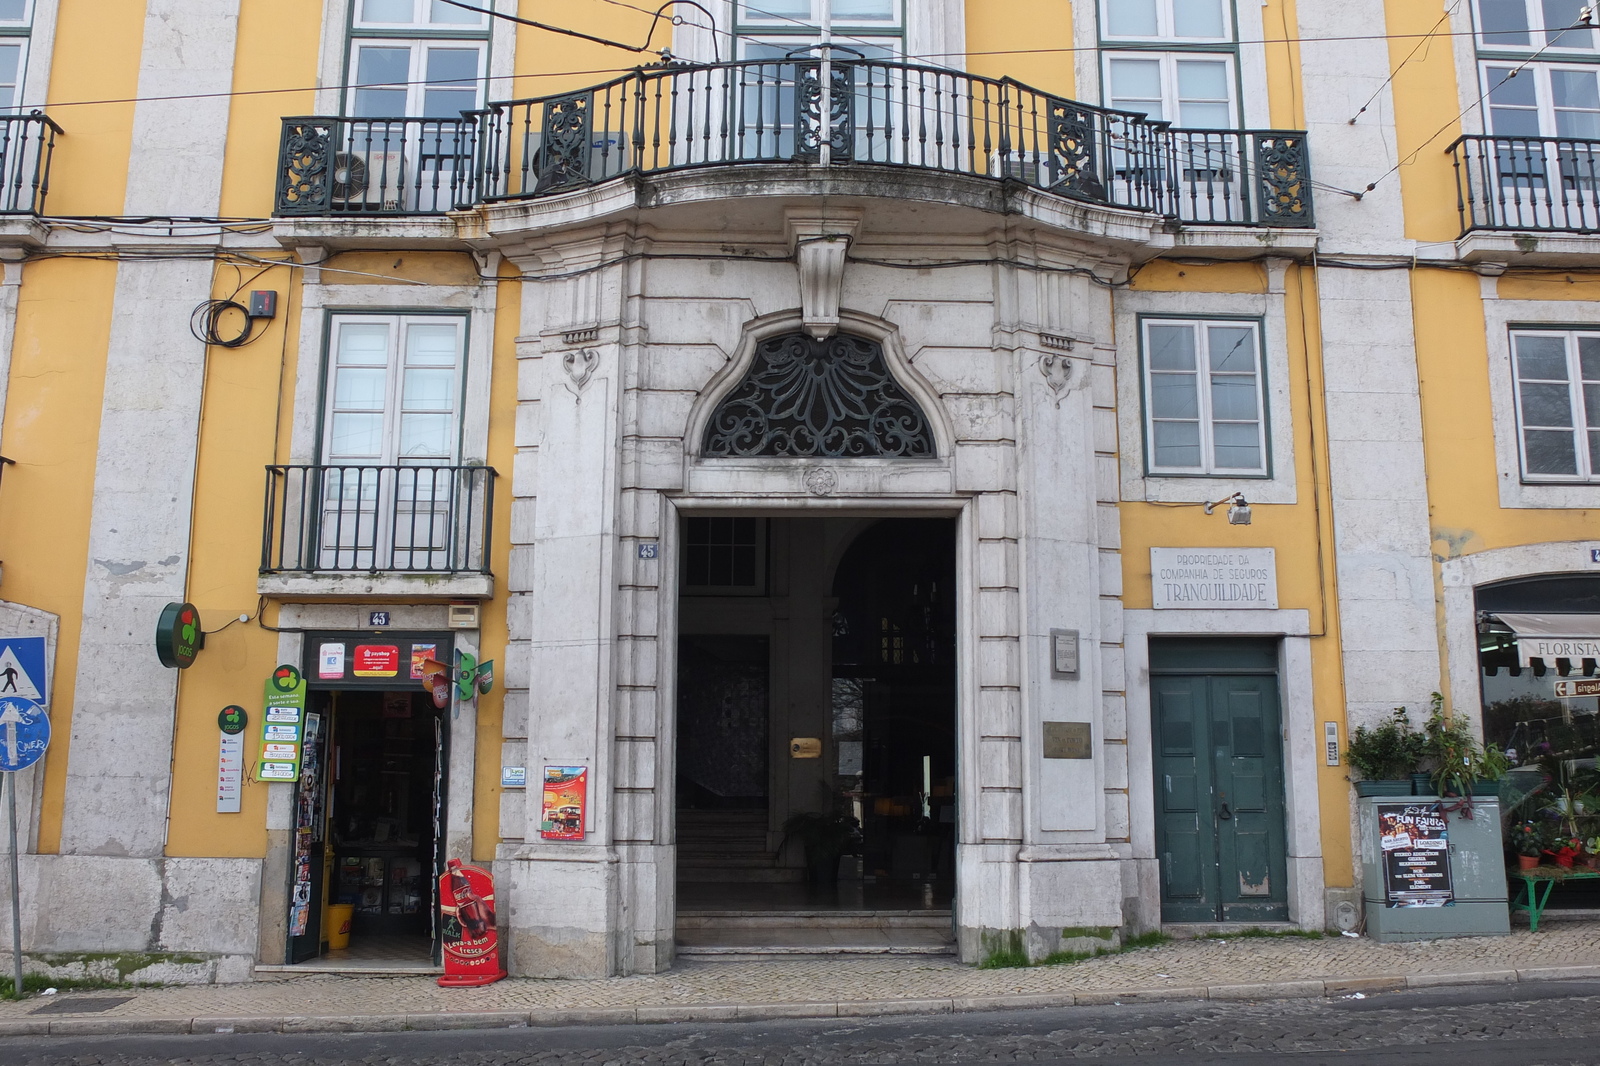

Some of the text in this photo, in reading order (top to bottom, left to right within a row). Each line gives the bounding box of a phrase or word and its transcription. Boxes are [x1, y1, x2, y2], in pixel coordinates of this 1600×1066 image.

[640, 545, 654, 558] 45
[1177, 554, 1249, 566] PROPRIEDADE DA
[1160, 568, 1268, 580] COMPANHIA DE SEGUROS
[1163, 583, 1267, 601] TRANQUILIDADE
[372, 612, 386, 625] 43
[177, 645, 193, 657] JOGOS
[1538, 642, 1600, 656] FLORISTA
[1396, 815, 1413, 825] FUN
[448, 936, 488, 949] Leva-a bem
[459, 946, 483, 955] fresca
